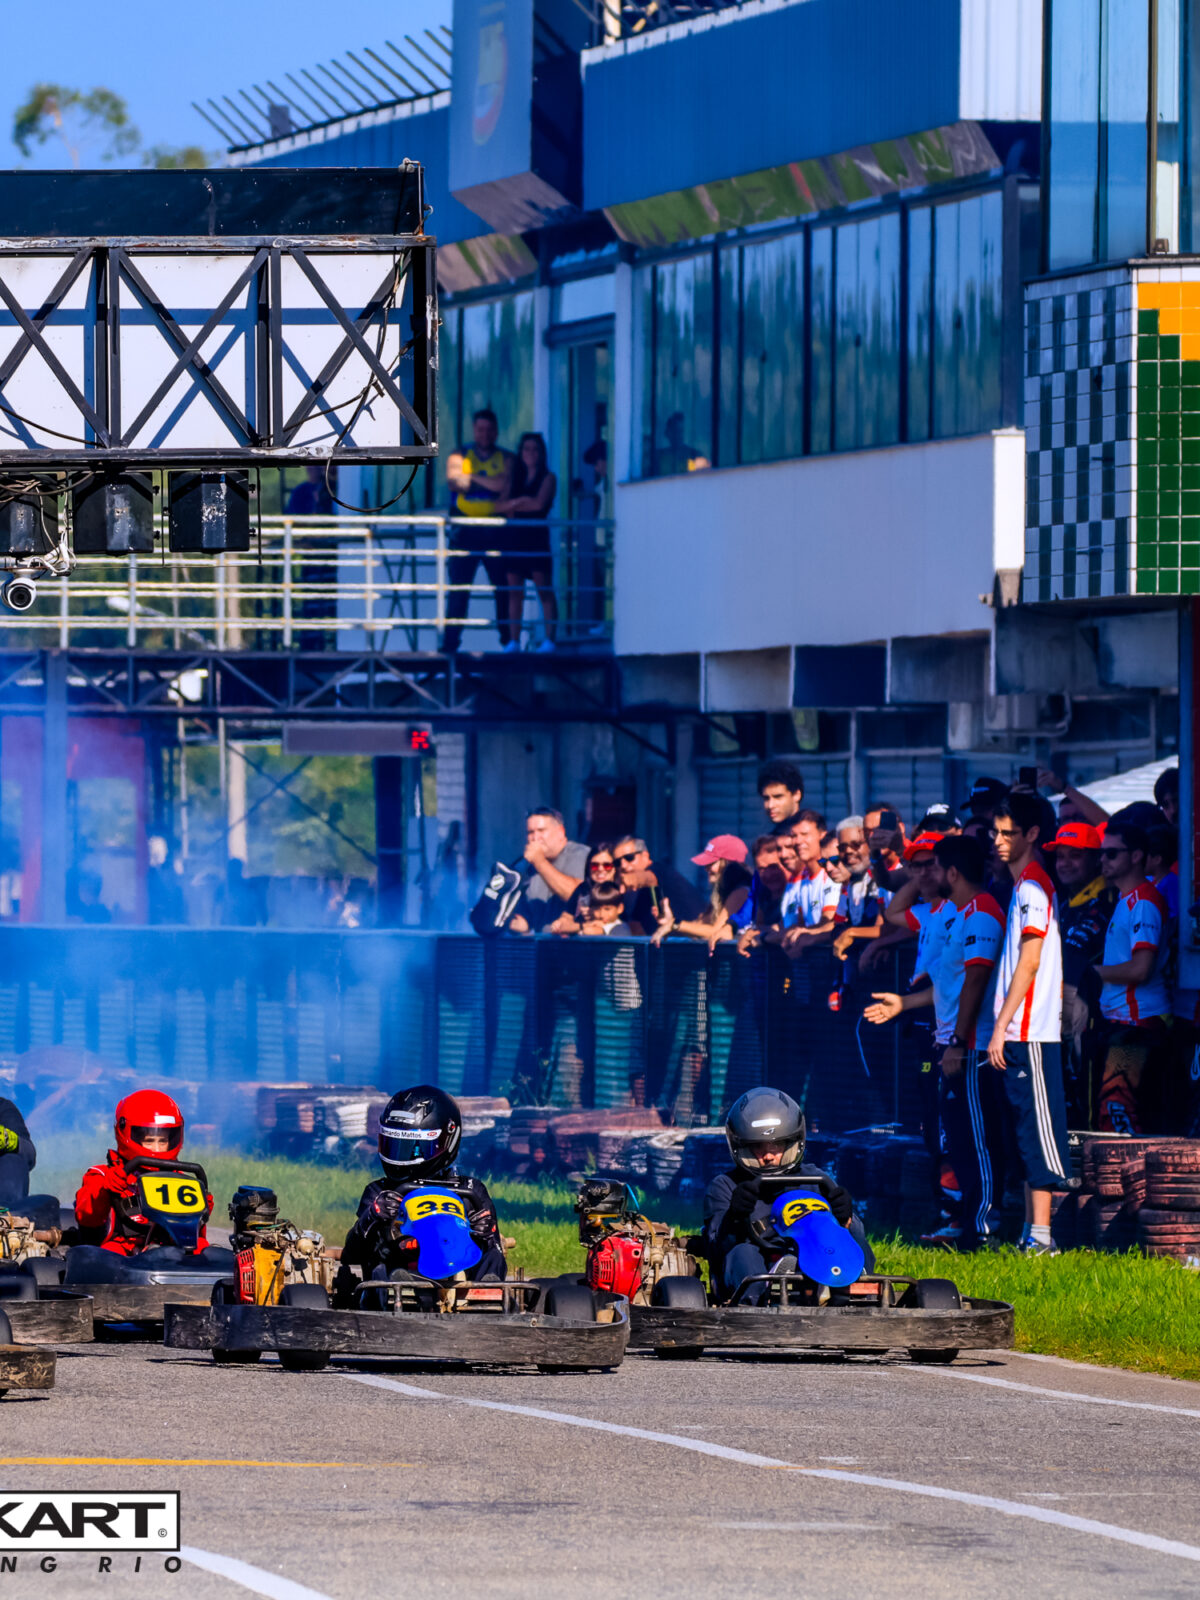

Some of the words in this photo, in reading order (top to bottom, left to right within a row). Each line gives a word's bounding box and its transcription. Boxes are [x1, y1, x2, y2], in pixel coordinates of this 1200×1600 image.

[401, 1131, 422, 1139] Mattos
[156, 1184, 198, 1206] 16
[416, 1201, 463, 1216] 38
